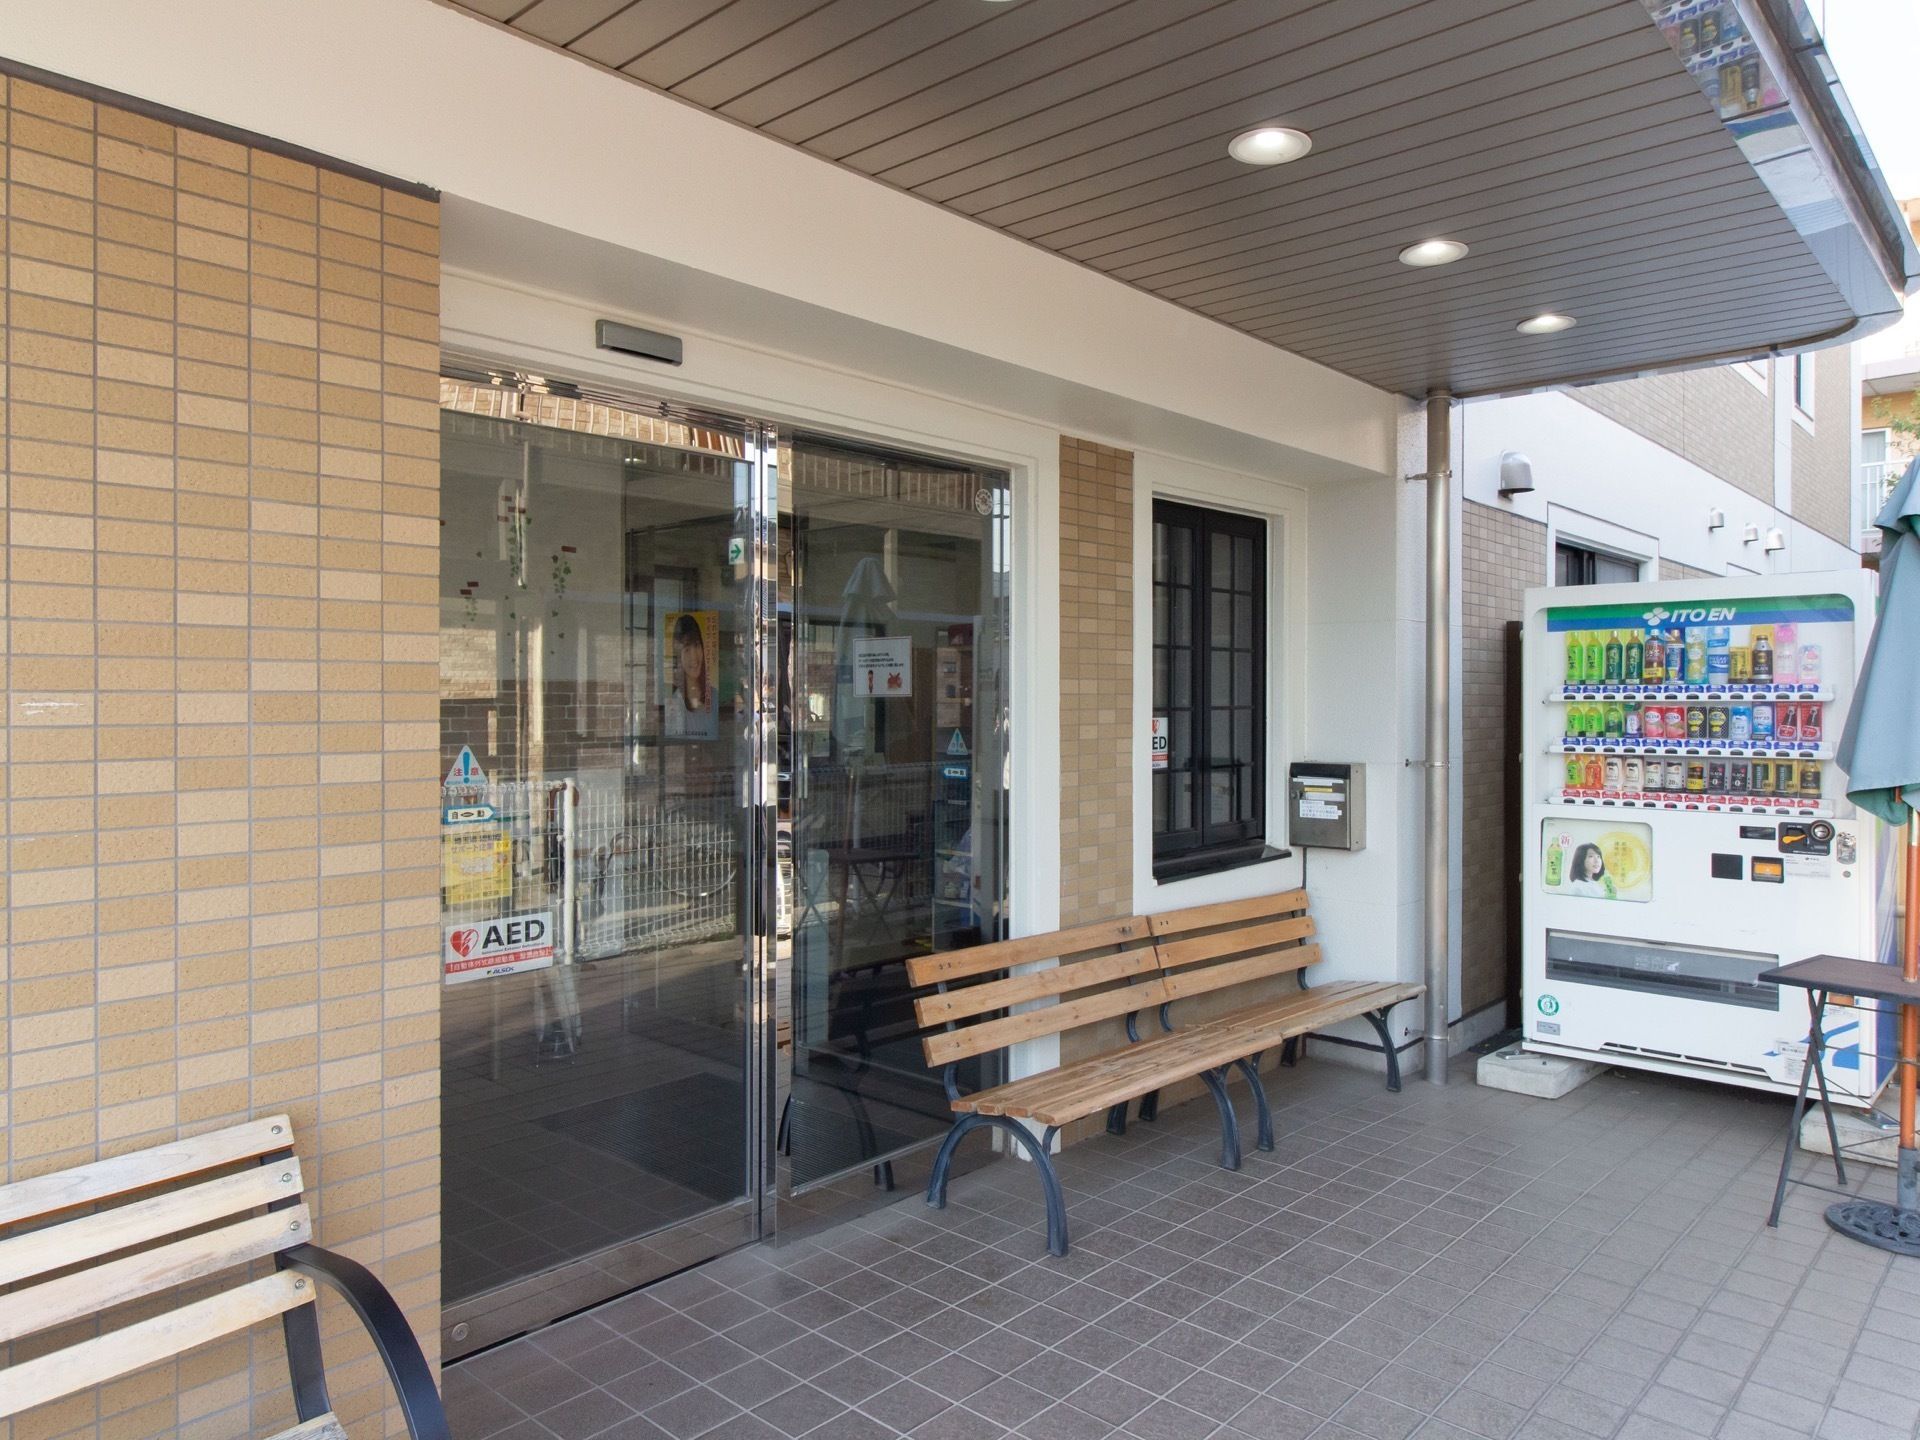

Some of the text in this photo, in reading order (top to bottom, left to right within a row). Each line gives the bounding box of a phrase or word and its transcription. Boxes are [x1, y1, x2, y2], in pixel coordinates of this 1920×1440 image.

[1671, 607, 1735, 622] ITO EN
[1152, 736, 1167, 750] ED
[482, 919, 545, 949] AED
